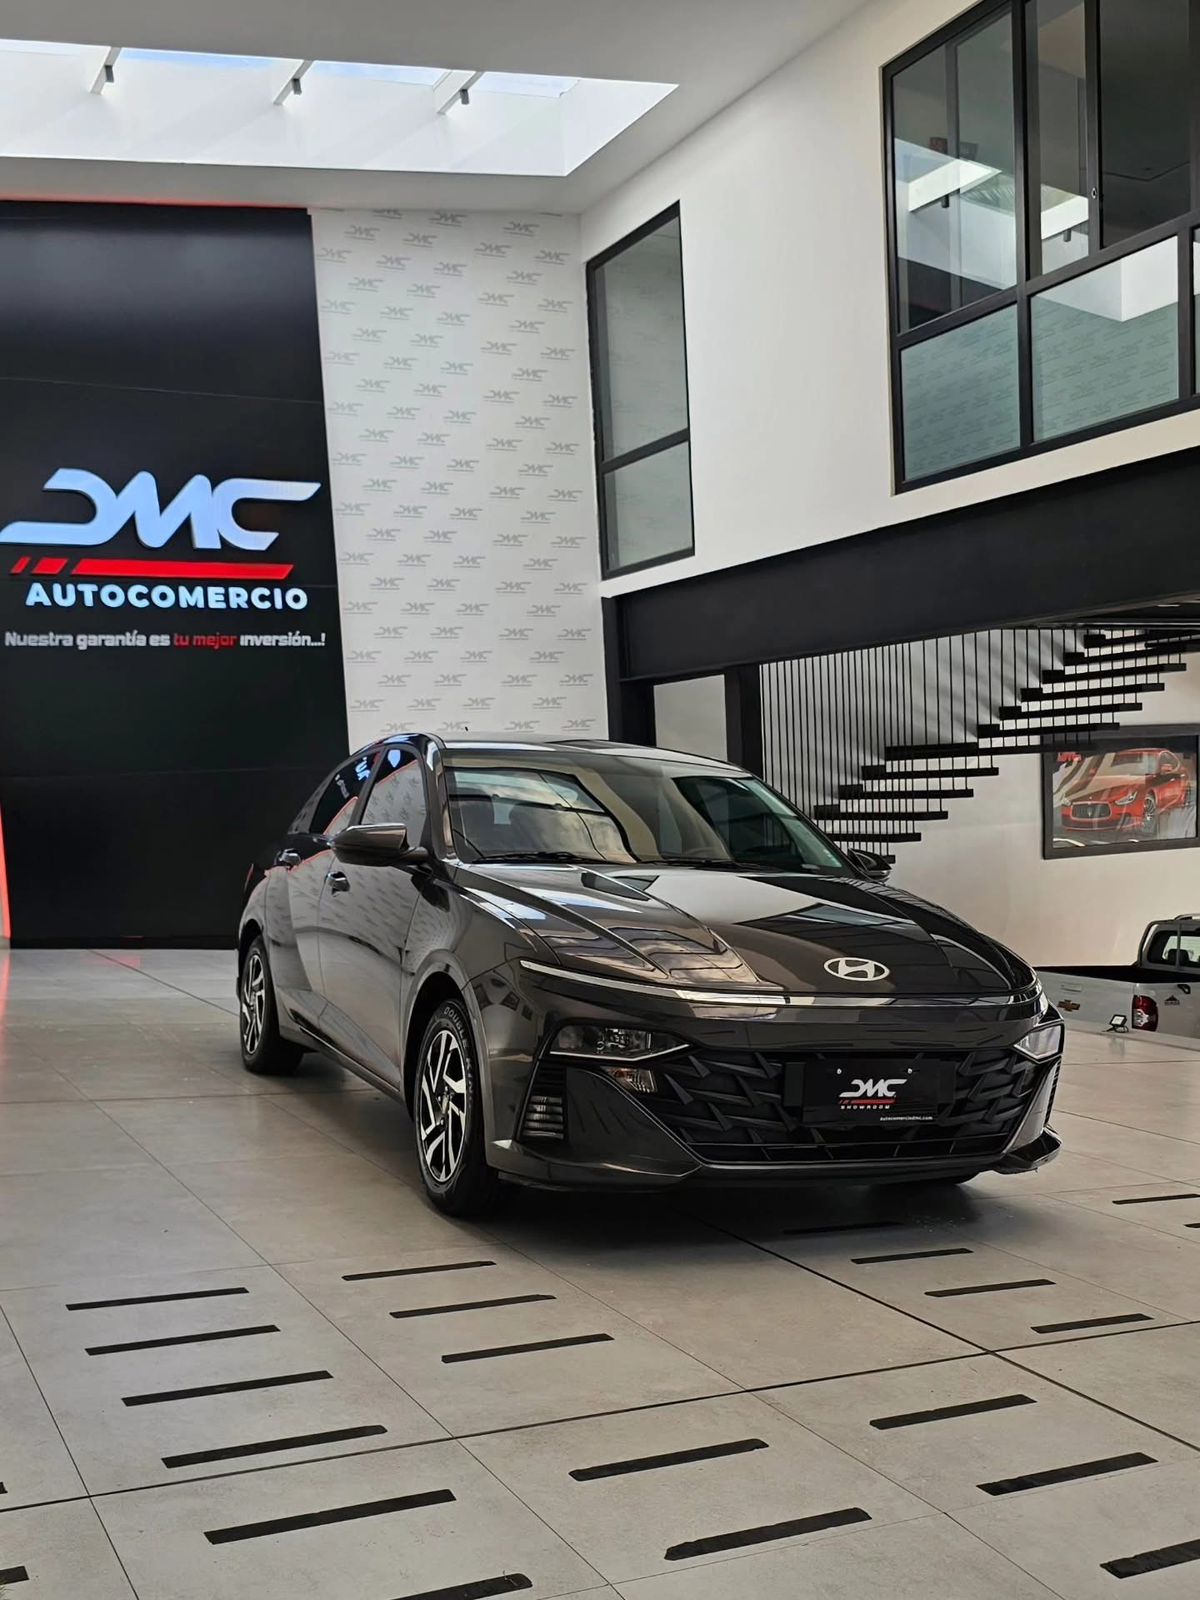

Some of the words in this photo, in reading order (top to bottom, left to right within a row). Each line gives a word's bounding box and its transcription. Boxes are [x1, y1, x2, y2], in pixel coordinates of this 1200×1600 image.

[0, 467, 322, 551] DMC
[25, 582, 309, 611] AUTOCOMERCIO
[4, 631, 74, 647] Nuestra
[76, 630, 147, 651] garantía
[149, 634, 171, 647] es
[173, 632, 189, 646] tu
[192, 632, 238, 650] mejor
[839, 1078, 908, 1098] DMC
